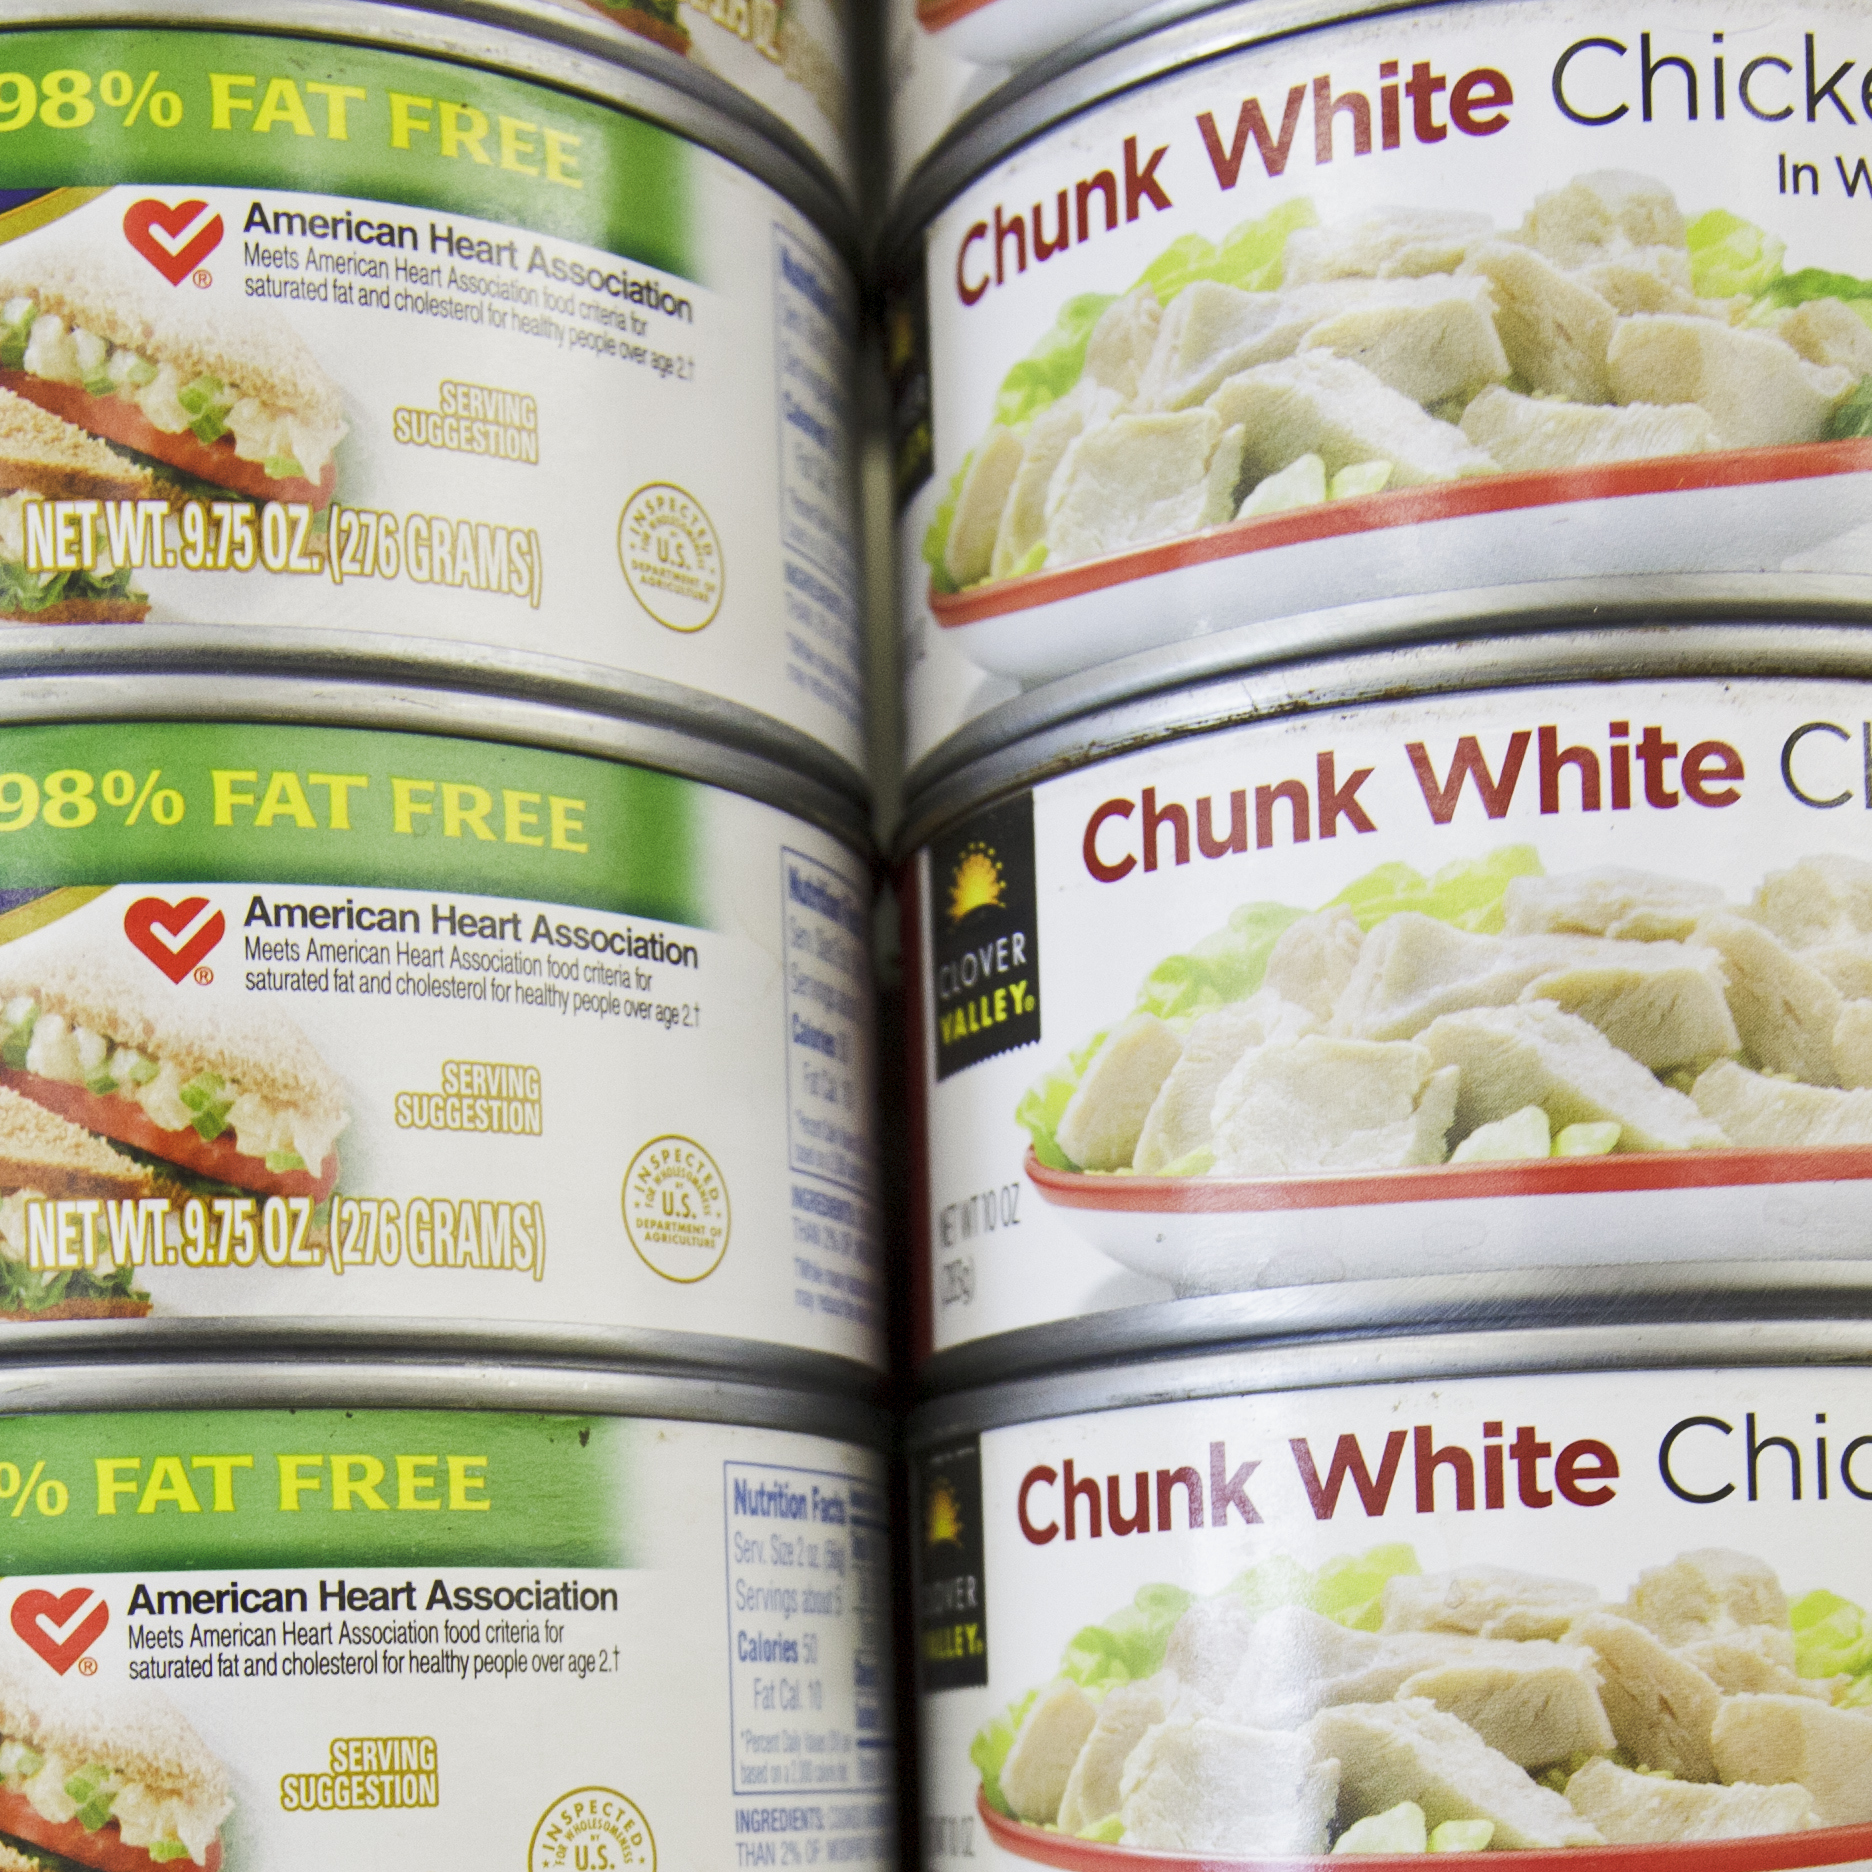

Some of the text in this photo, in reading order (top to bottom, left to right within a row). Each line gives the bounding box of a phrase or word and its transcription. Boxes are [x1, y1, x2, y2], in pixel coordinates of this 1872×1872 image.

[210, 71, 364, 140] FAT
[391, 93, 585, 188] FREE
[954, 133, 1174, 306] Chunk
[1197, 58, 1515, 191] White
[1082, 752, 1378, 885] Chunk
[1406, 720, 1746, 828] White
[940, 932, 1027, 1001] CLOVER
[96, 1454, 253, 1515] FAT
[276, 1454, 492, 1512] FREE
[733, 1477, 807, 1519] Nutrition
[1018, 1441, 1262, 1545] Chunk
[1291, 1422, 1619, 1519] White
[127, 1580, 618, 1615] American Heart Association
[128, 1619, 564, 1649] Meets American Heart Association food criteria for
[737, 1630, 798, 1663] Calories
[128, 1653, 212, 1680] saturated
[217, 1653, 239, 1677] fat
[245, 1652, 278, 1677] and
[282, 1650, 378, 1676] cholesterol
[382, 1650, 405, 1674] for
[409, 1650, 469, 1679] healthy
[473, 1650, 527, 1679] people
[532, 1653, 563, 1672] over
[568, 1654, 595, 1679] age
[331, 1739, 436, 1772] SERVING
[282, 1774, 437, 1810] SUGGESTION
[542, 1799, 643, 1851] INSPECTED
[574, 1844, 615, 1871] U.S.
